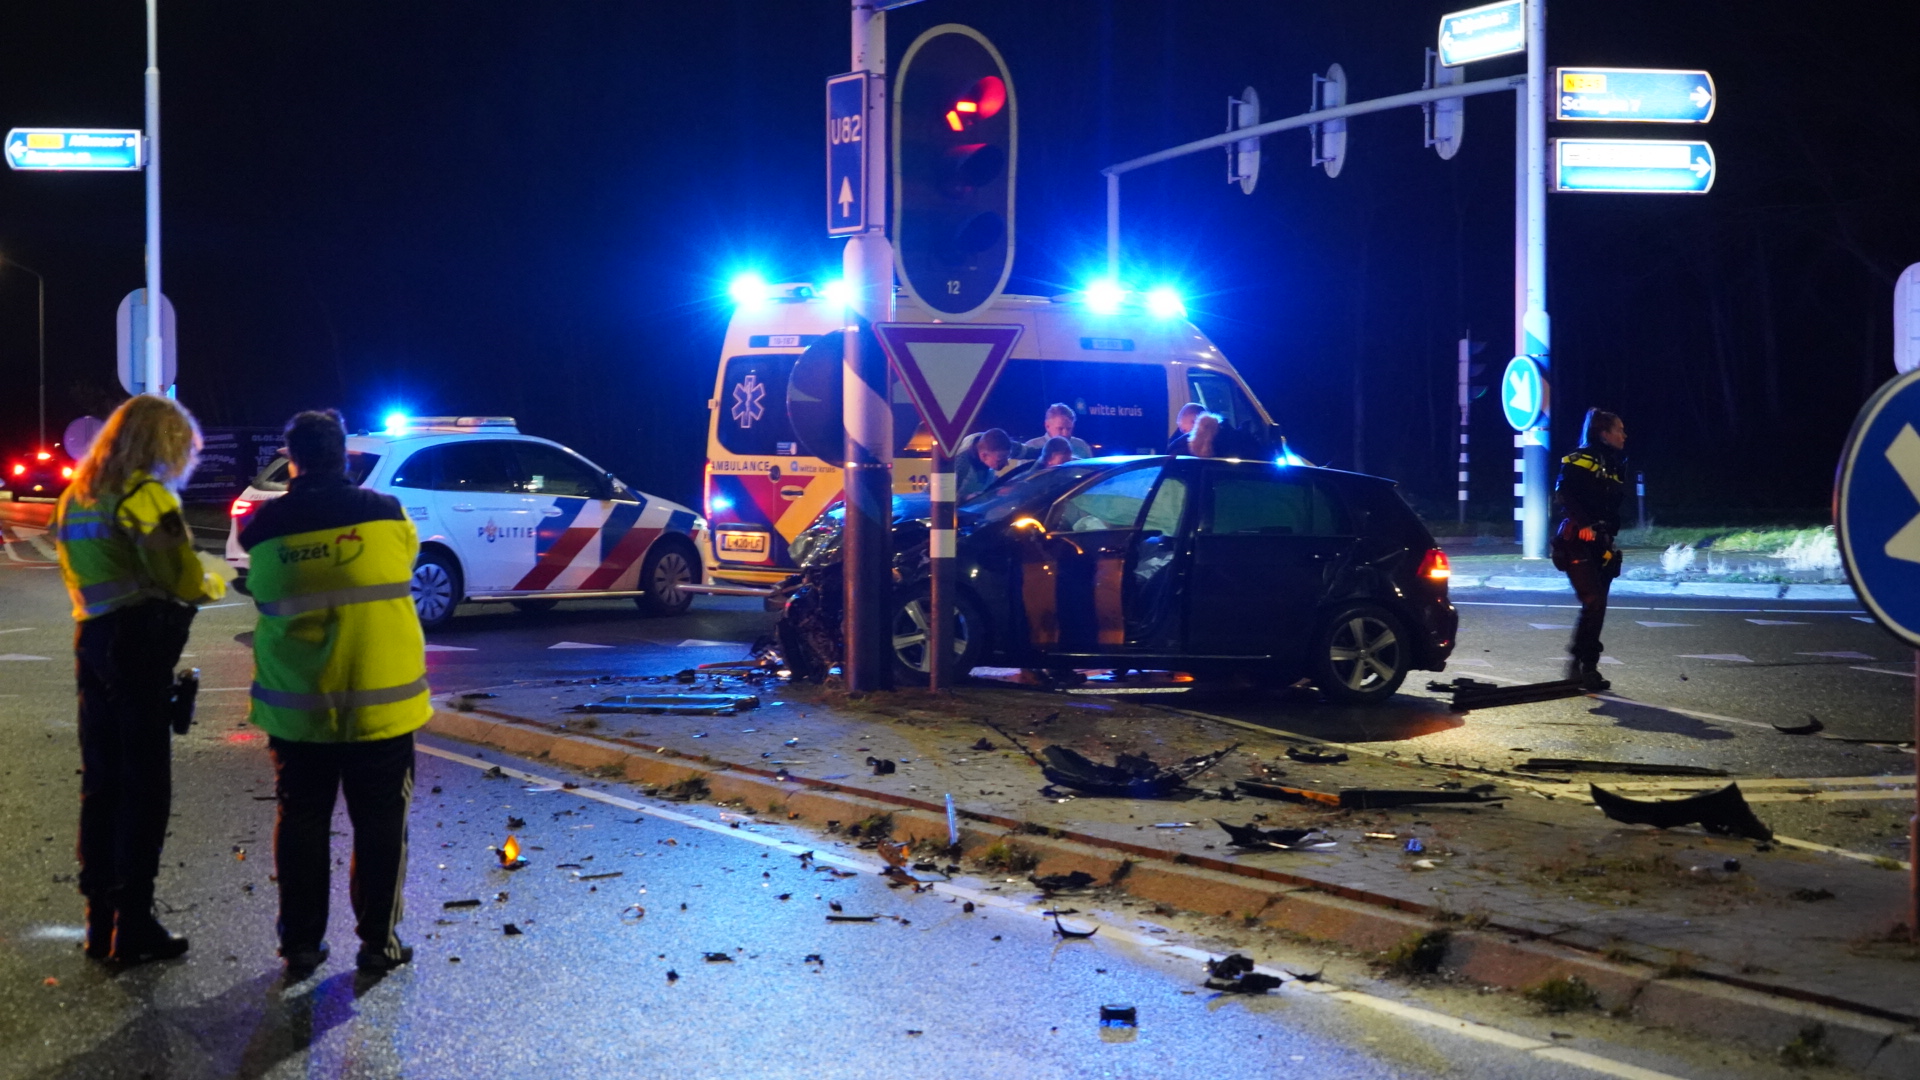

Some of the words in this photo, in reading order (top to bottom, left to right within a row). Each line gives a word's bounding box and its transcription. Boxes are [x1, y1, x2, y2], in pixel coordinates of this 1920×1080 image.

[831, 114, 862, 145] U82
[947, 281, 961, 295] 12
[1088, 403, 1116, 416] witte
[1118, 404, 1143, 417] kruis
[711, 460, 770, 471] AMBULANCE
[800, 465, 817, 473] witte
[477, 525, 534, 543] POLITIE
